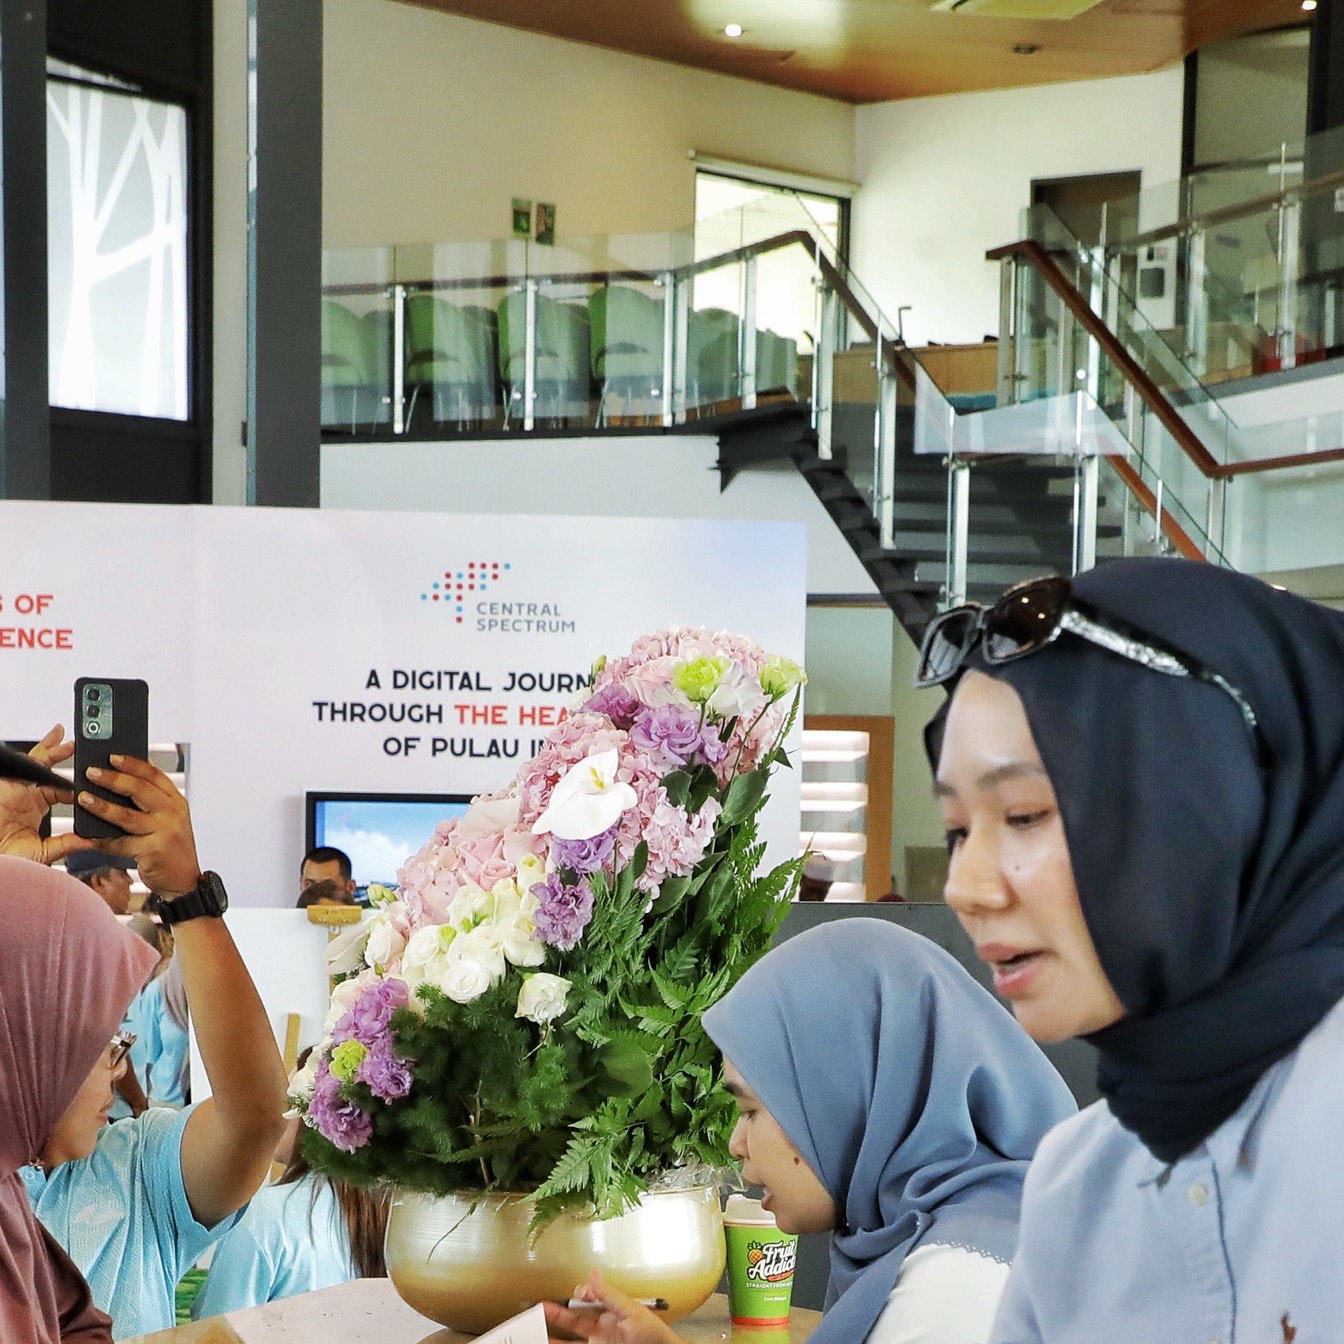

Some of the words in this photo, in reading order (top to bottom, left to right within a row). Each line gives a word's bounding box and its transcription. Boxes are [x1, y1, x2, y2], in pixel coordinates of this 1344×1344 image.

[14, 594, 54, 615] OF
[476, 602, 561, 617] CENTRAL
[476, 618, 576, 633] SPECTRUM
[365, 669, 381, 690] A
[392, 670, 492, 691] DIGITAL
[312, 701, 443, 724] THROUGH
[454, 704, 508, 725] THE
[383, 736, 421, 757] OF
[431, 737, 519, 758] PULAU
[762, 1240, 796, 1264] Fruit
